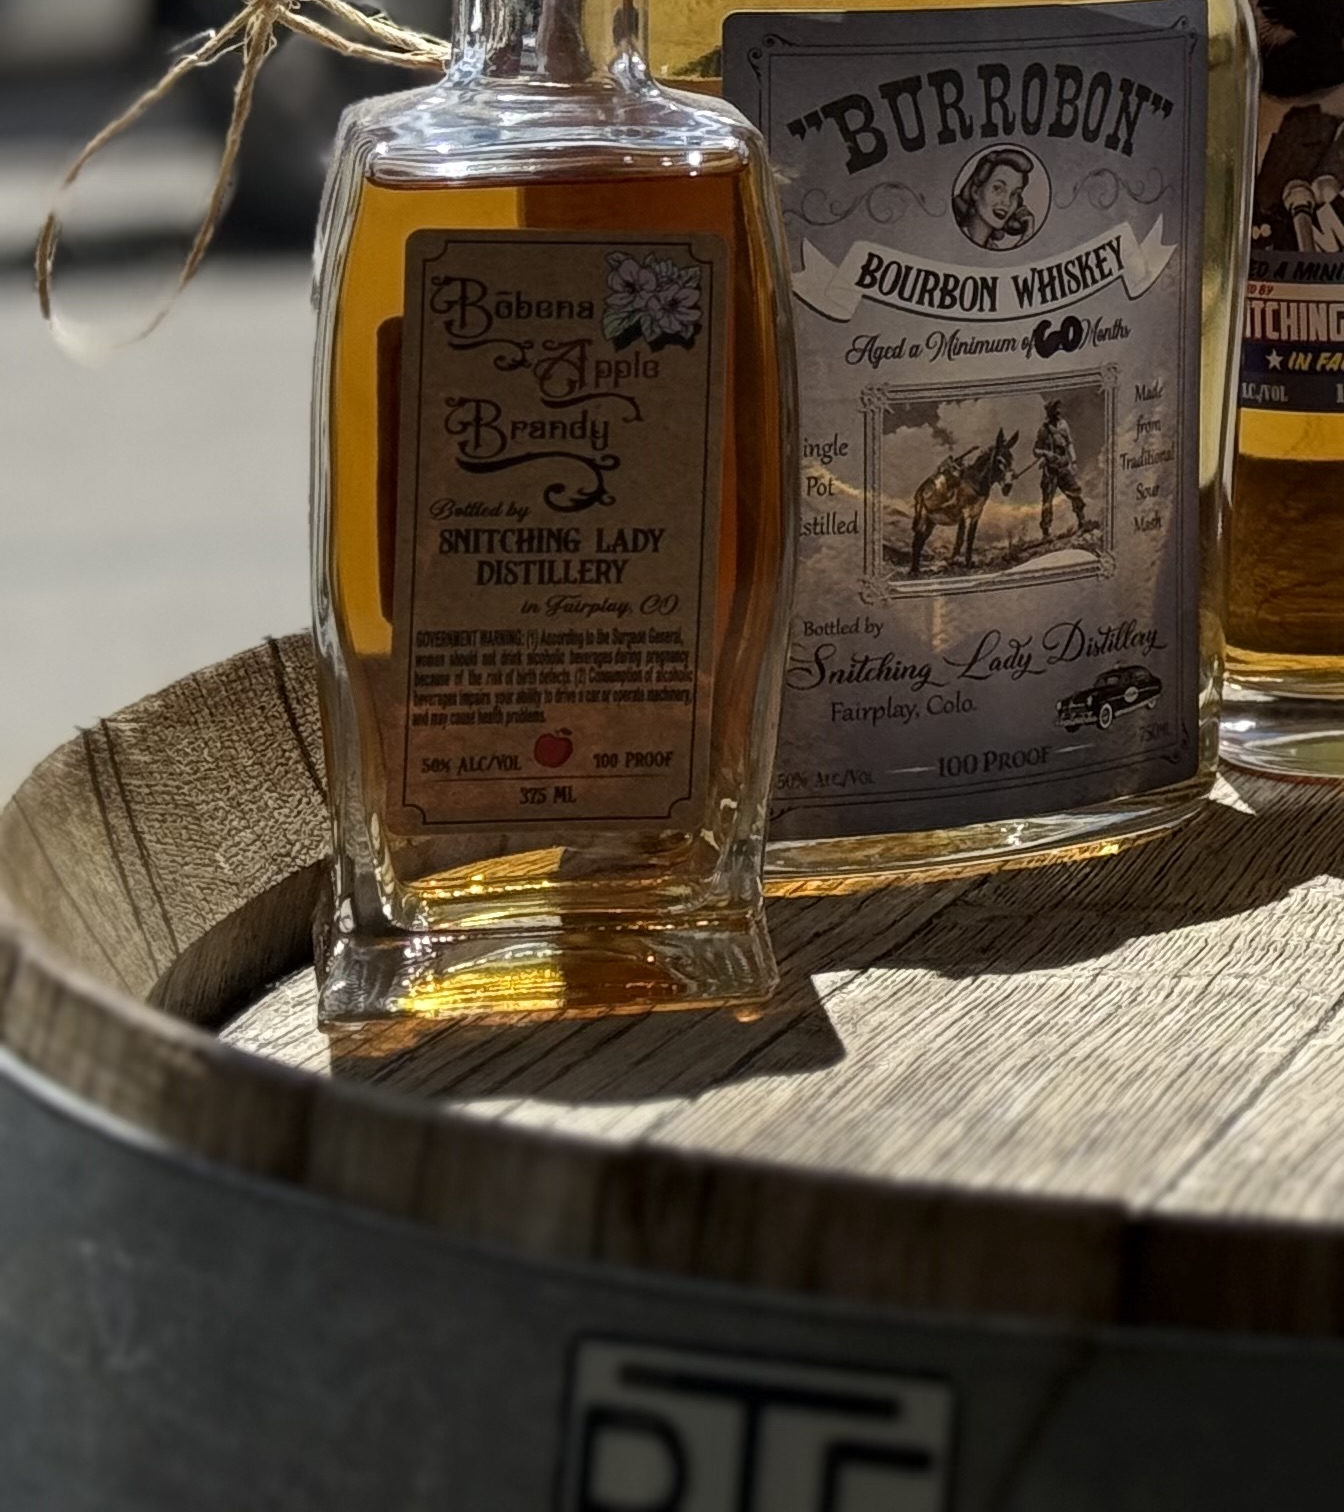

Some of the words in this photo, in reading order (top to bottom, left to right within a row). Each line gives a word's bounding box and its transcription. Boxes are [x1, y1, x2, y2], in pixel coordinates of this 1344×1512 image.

[853, 250, 1000, 313] BOURBON
[1009, 233, 1128, 310] WHISKEY
[1274, 261, 1289, 280] A
[844, 333, 906, 369] Aged
[909, 342, 924, 358] a
[926, 329, 1015, 362] Minimum
[1080, 319, 1133, 349] Months
[533, 337, 661, 399] Apple
[1287, 350, 1313, 371] IN
[444, 395, 610, 461] Brandy
[1133, 413, 1162, 442] from
[803, 432, 850, 466] ingle
[806, 475, 836, 498] Pot
[429, 498, 503, 522] Bottled
[506, 500, 531, 523] by
[438, 528, 583, 555] SNITCHING
[596, 527, 668, 553] LADY
[475, 559, 632, 586] DISTILLERY
[520, 599, 541, 615] in
[639, 592, 681, 615] CO
[803, 618, 862, 639] Bottled
[865, 619, 885, 638] by
[784, 641, 948, 692] Snitching
[943, 628, 1048, 679] Lady
[1041, 616, 1168, 668] Distillery
[831, 699, 921, 730] Fairplay,
[925, 694, 978, 715] Colo.
[592, 752, 620, 770] 100
[624, 749, 676, 769] PROOF
[937, 753, 979, 776] 100
